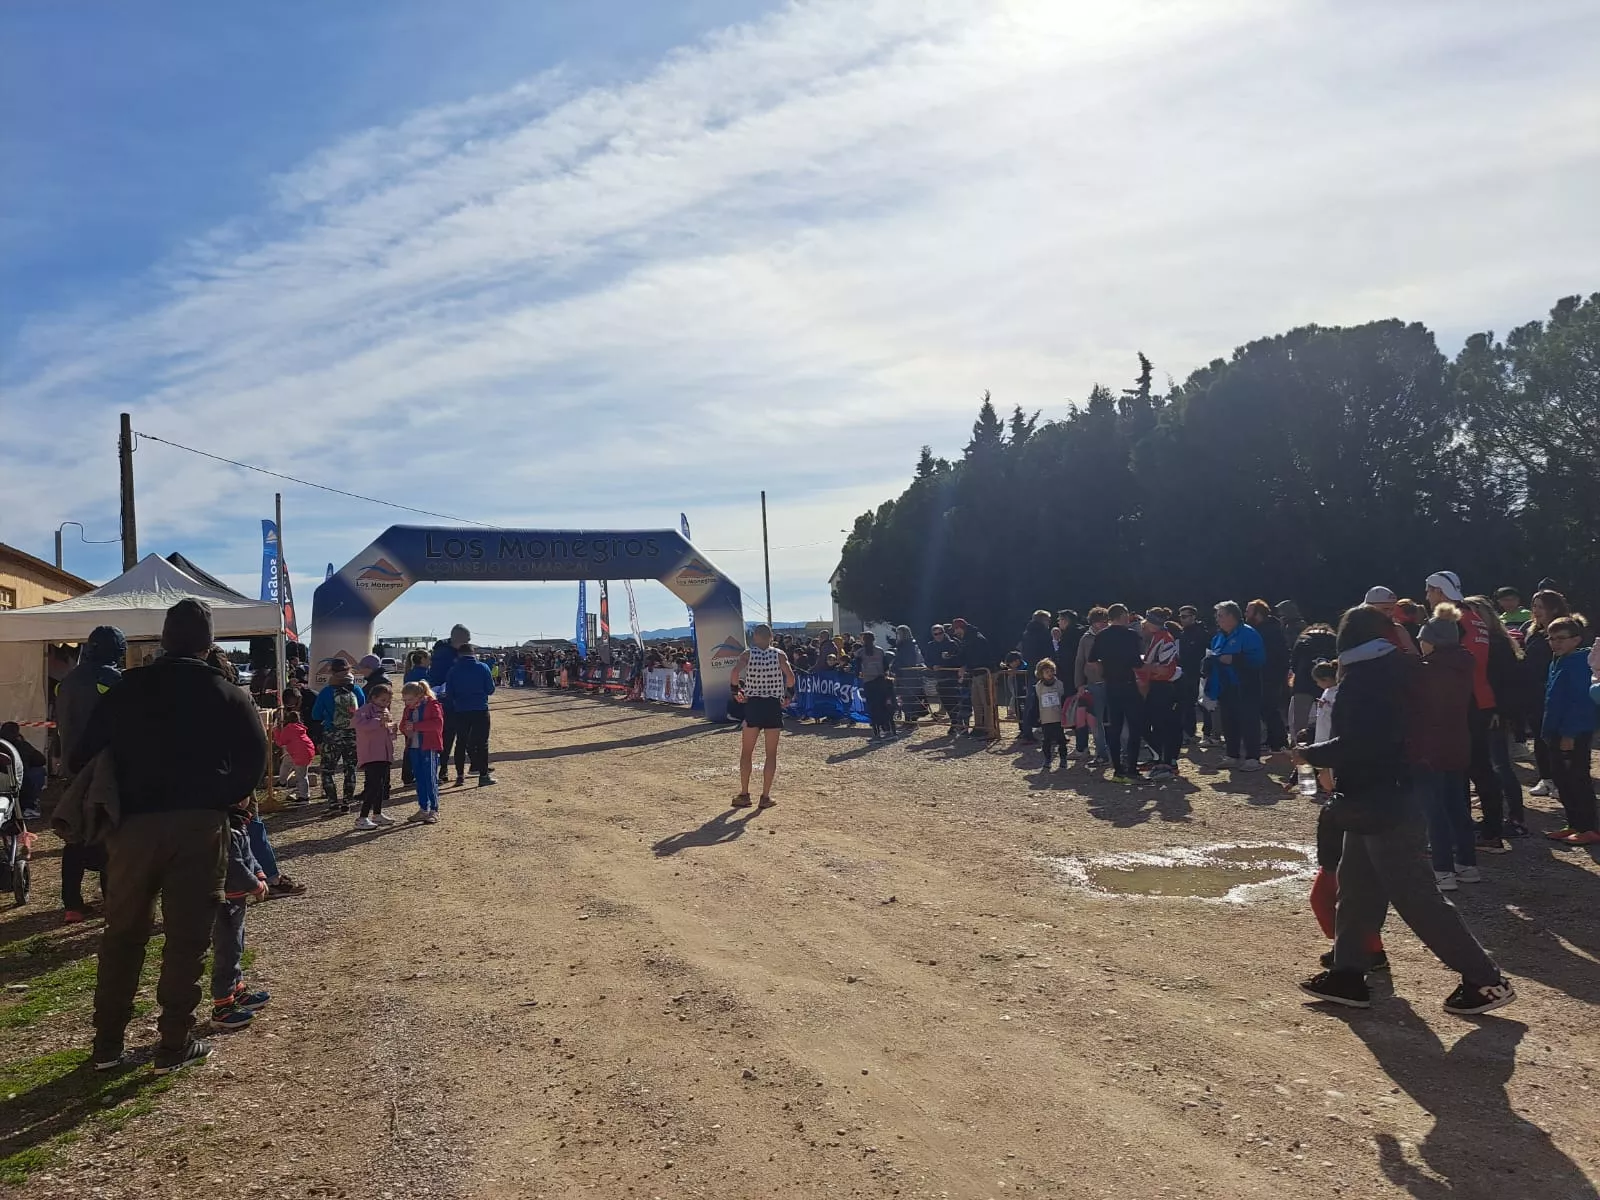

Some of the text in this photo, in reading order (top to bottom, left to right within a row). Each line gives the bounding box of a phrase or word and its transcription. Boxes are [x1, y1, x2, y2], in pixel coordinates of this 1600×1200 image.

[425, 532, 660, 564] Los Monegros
[425, 561, 592, 574] CONSEJO COMARCAL
[356, 580, 369, 588] Los
